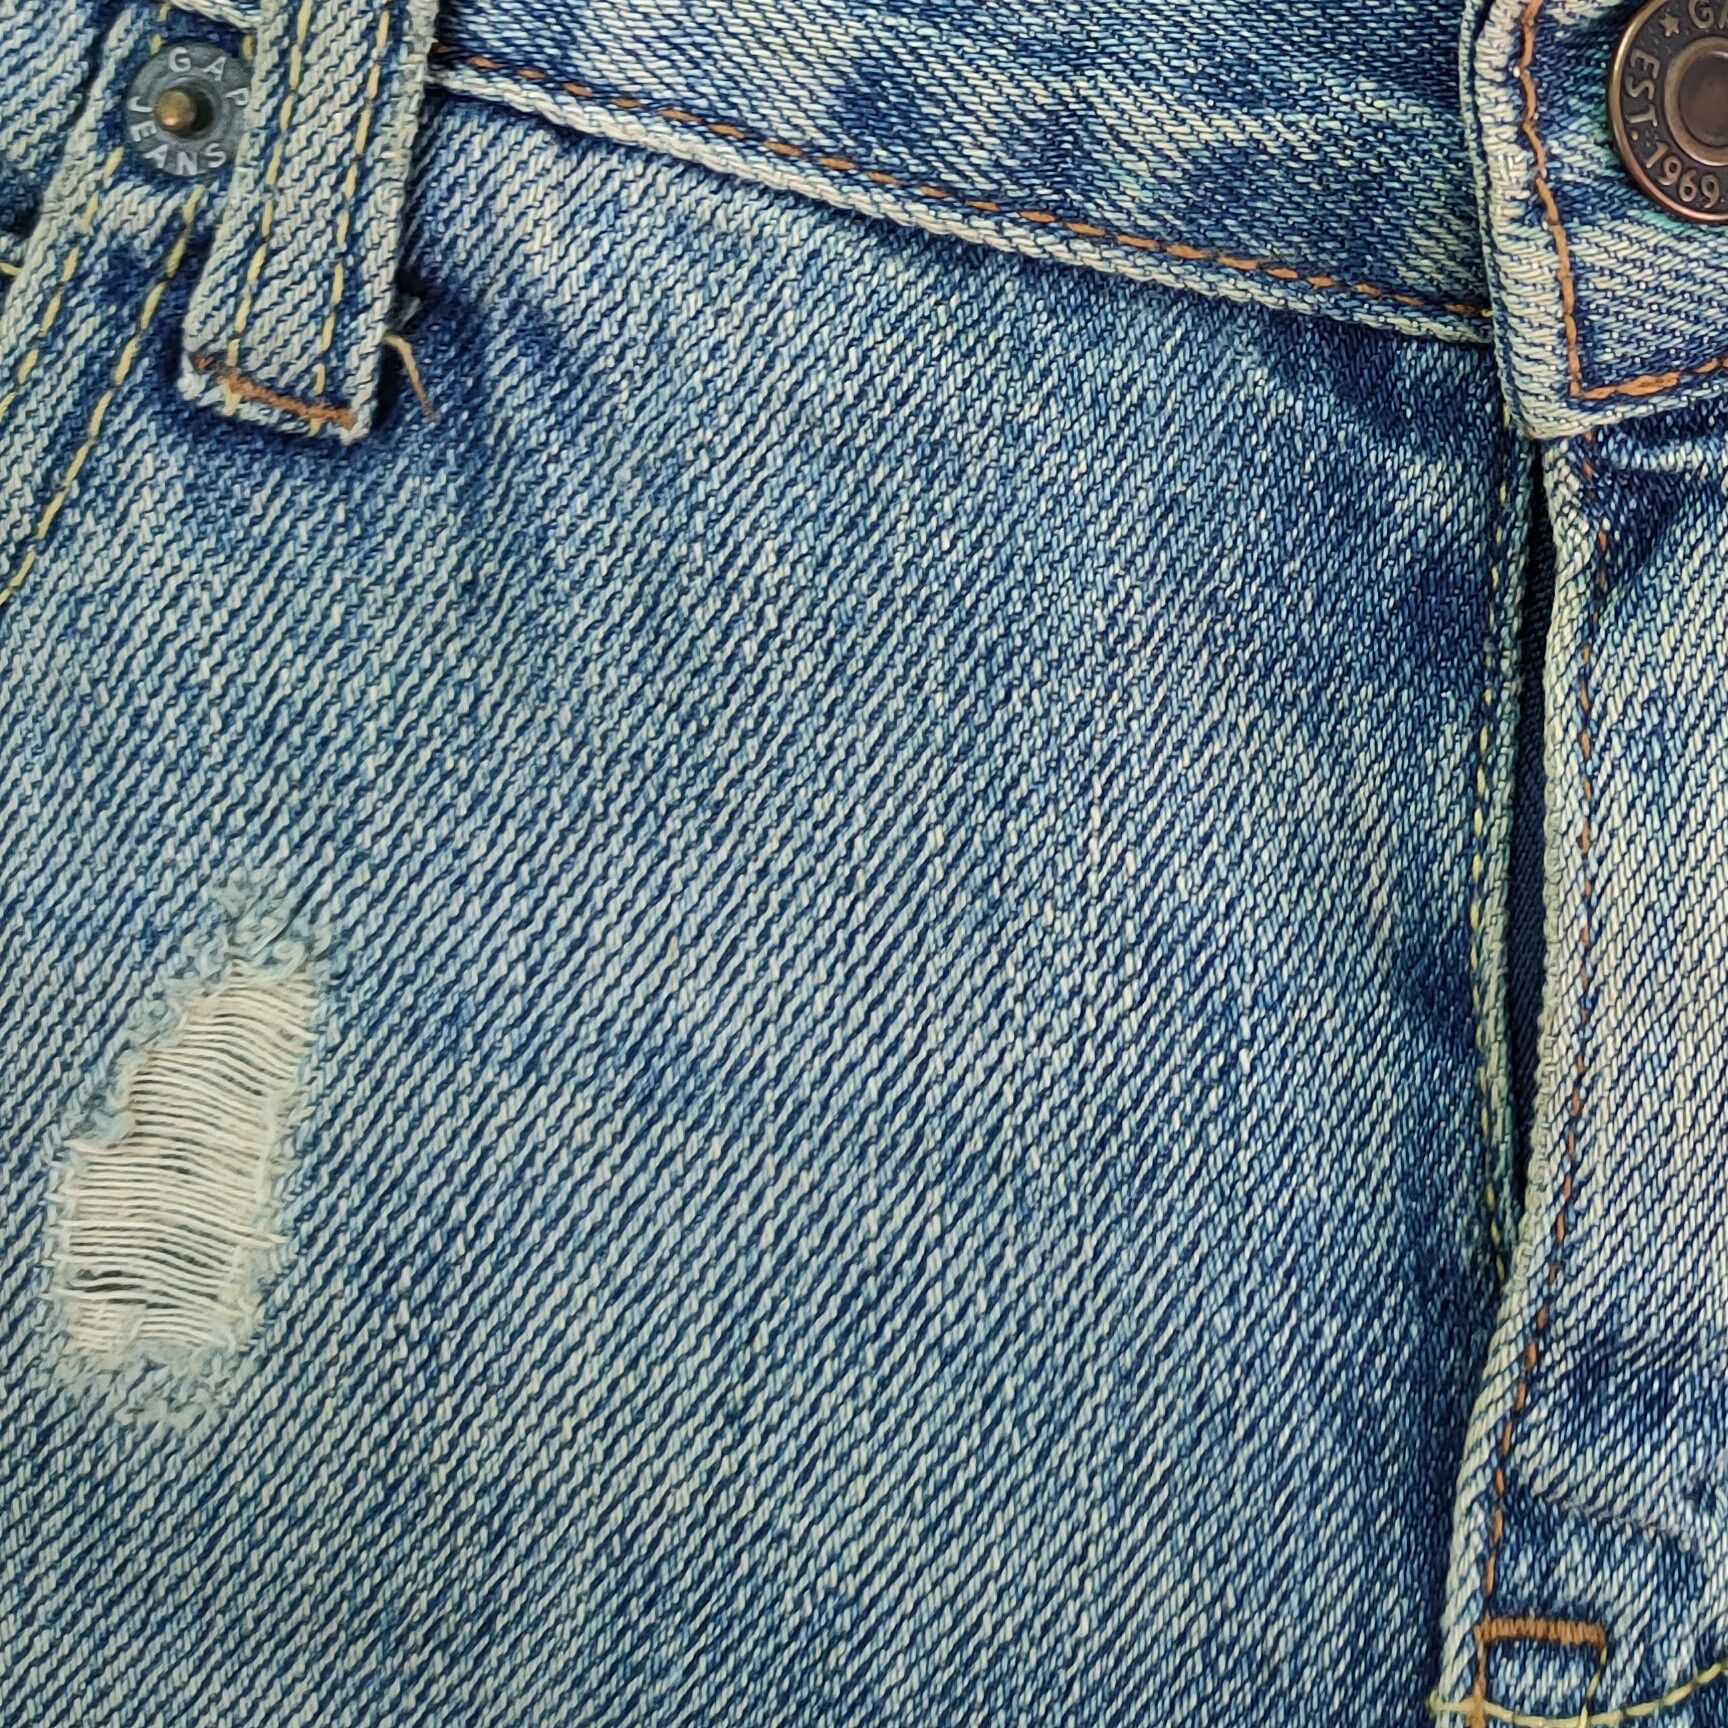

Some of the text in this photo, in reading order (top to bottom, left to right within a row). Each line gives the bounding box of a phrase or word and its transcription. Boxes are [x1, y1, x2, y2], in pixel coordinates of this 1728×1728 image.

[170, 47, 250, 106] GAP
[127, 96, 227, 176] JEANS
[1645, 141, 1720, 208] 1969
